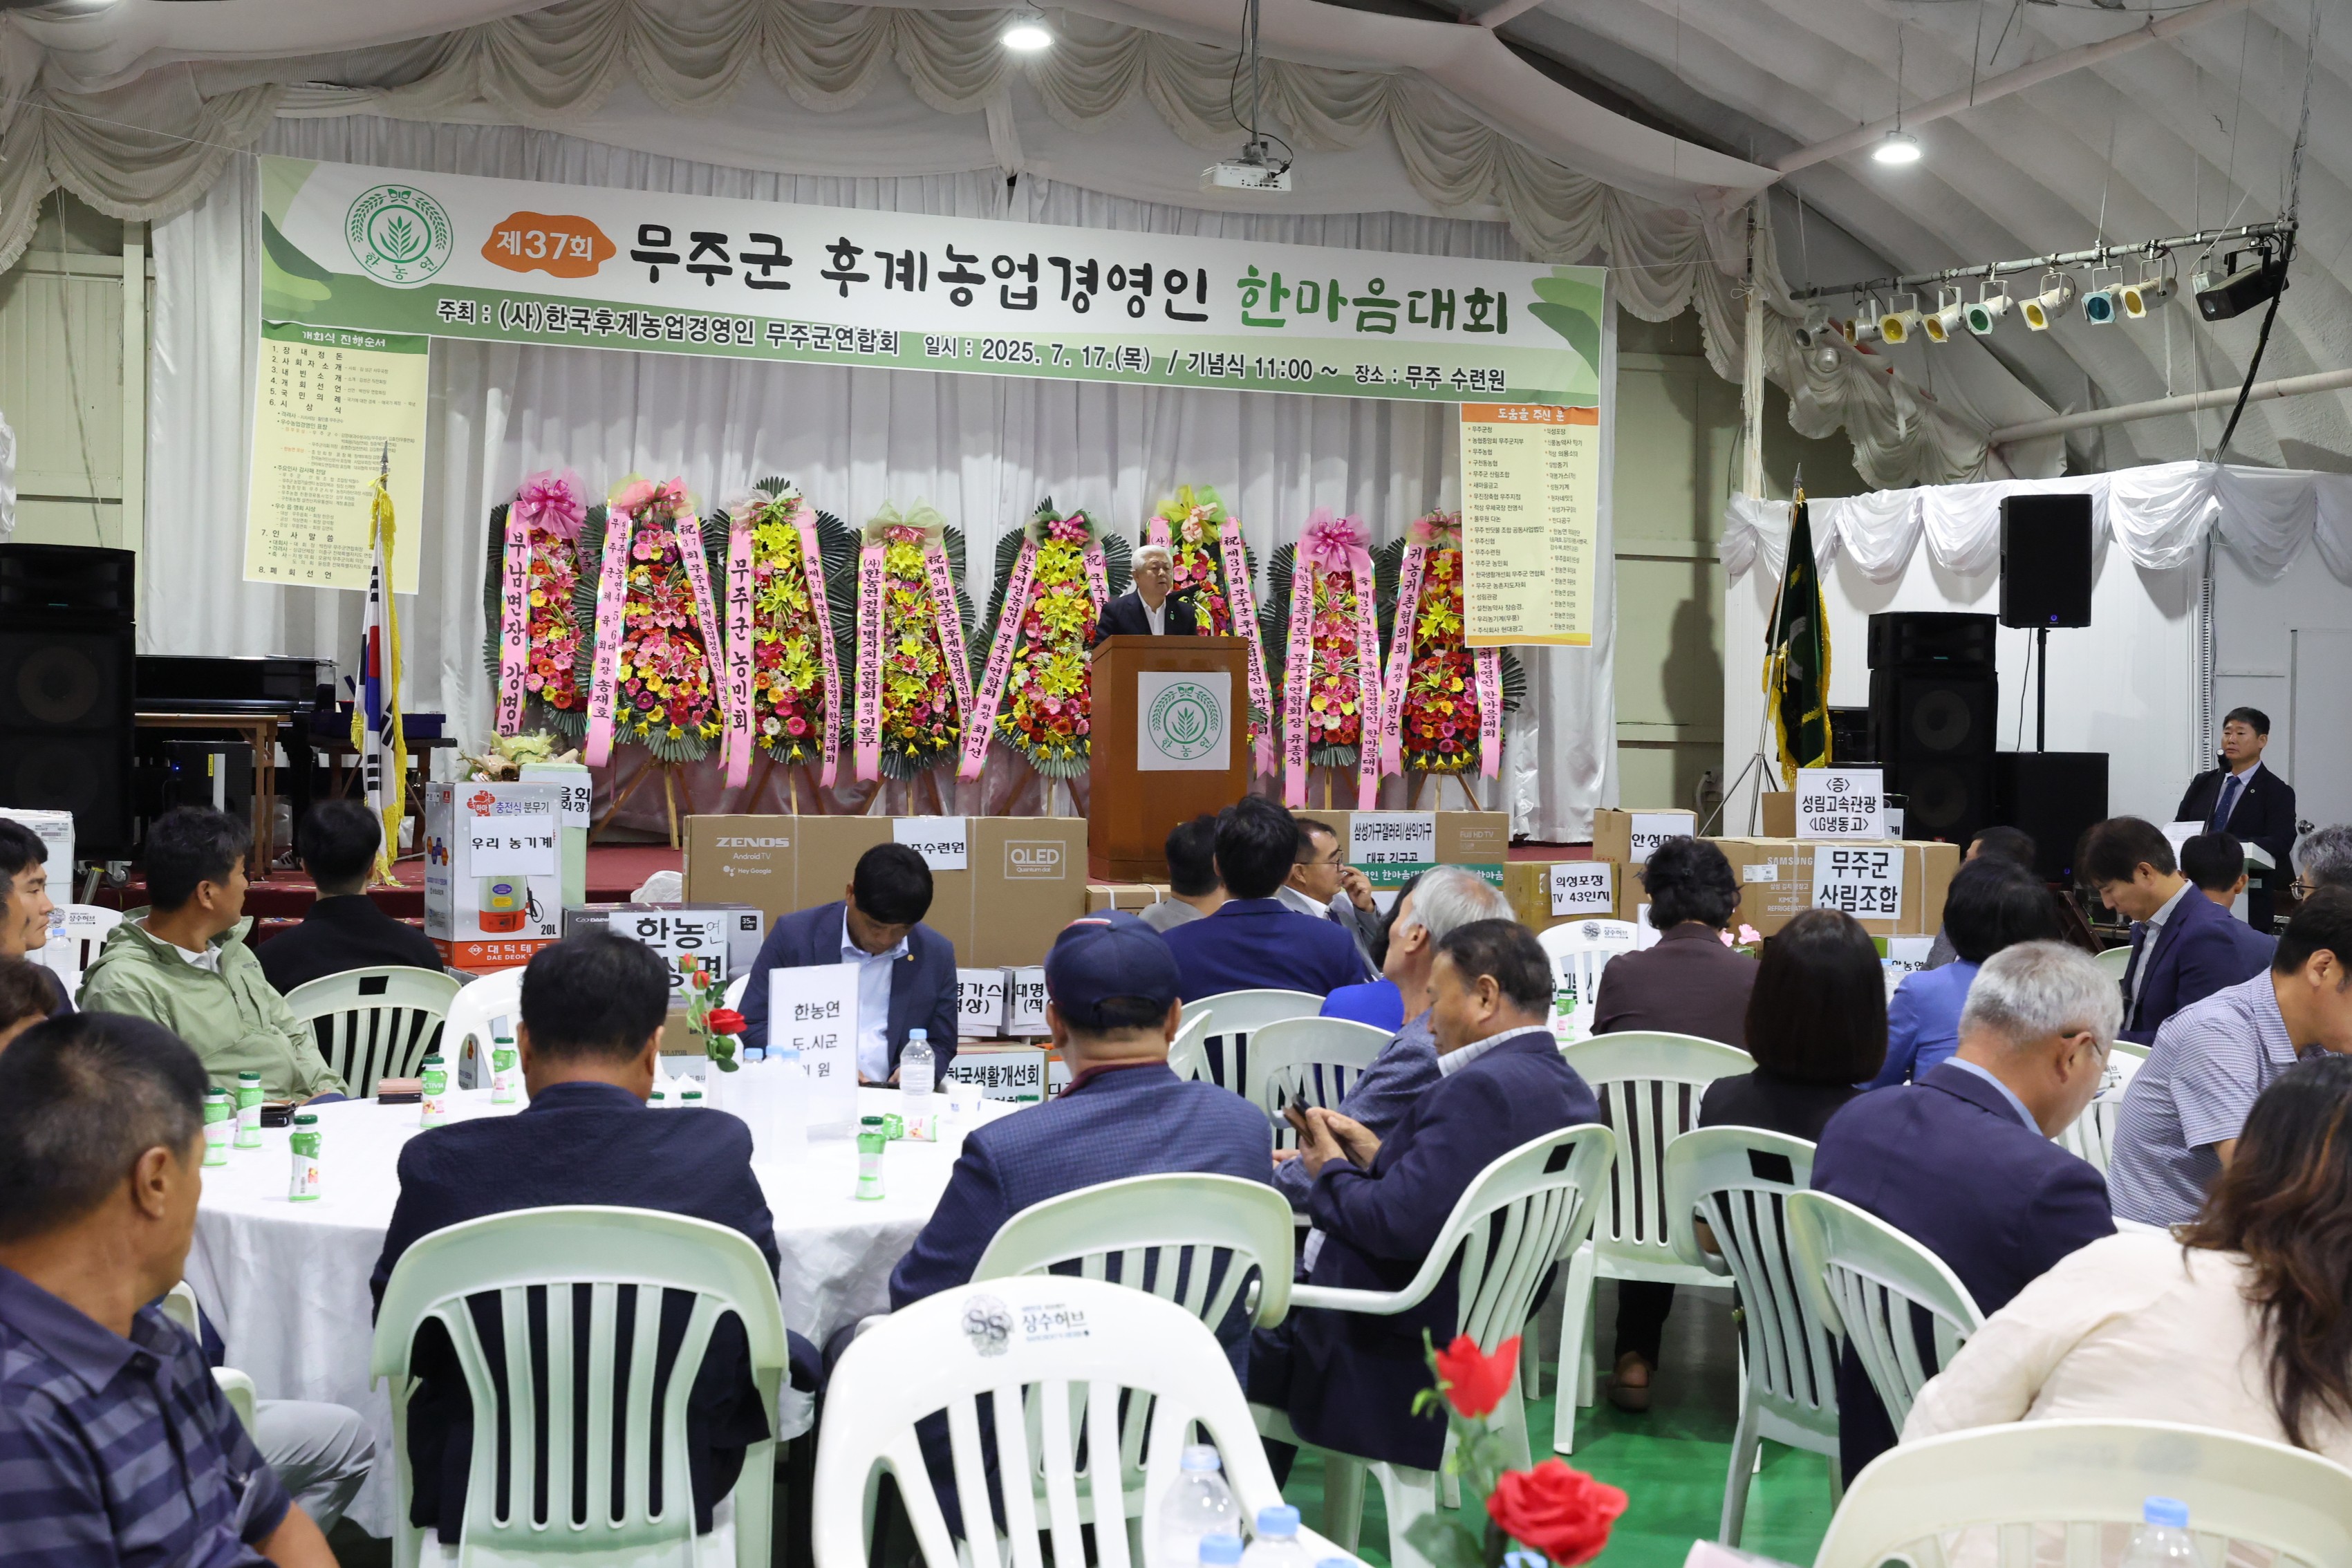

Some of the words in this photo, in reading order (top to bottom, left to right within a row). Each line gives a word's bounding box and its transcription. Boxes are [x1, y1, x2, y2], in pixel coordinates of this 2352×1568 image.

[496, 229, 594, 262] 제37회
[630, 223, 793, 291] 무주군
[821, 236, 1209, 322] 후계농업경영인
[1237, 264, 1509, 335] 한마음대회
[301, 330, 336, 343] 개회식
[340, 334, 386, 348] 진행순서
[437, 299, 475, 324] 주최
[498, 301, 756, 346] (사)한국후계농업경영인
[765, 323, 899, 355] 무주군연합회
[924, 335, 958, 357] 일시
[982, 339, 1040, 365] 2025.
[1050, 344, 1072, 366] 7.
[1082, 347, 1151, 373] 17.(목)
[1186, 351, 1245, 380] 기념식
[1255, 356, 1313, 381] 11:00
[1354, 364, 1385, 386] 장소
[1404, 364, 1442, 391] 무주
[1450, 368, 1506, 393] 수련원
[1497, 407, 1529, 420] 도움을
[1533, 409, 1551, 422] 주신
[1556, 409, 1565, 422] 분
[504, 532, 527, 647] 부남면장
[730, 557, 751, 642] 무주군
[1394, 546, 1424, 657] 귀농귀촌협의회
[982, 632, 1014, 700] 무주군연합회
[730, 651, 751, 736] 농민회
[1482, 690, 1499, 738] 한마음대회
[824, 711, 841, 765] 한마음대회
[967, 724, 987, 760] 최미선
[496, 801, 522, 813] 충전식
[523, 801, 550, 813] 분무기
[1802, 795, 1876, 814] 성림고속관광
[715, 837, 790, 848] ZENOS
[1354, 822, 1432, 841] 삼성가구갤러리/삼익가구
[472, 837, 499, 850] 우리
[509, 837, 553, 850] 농기계
[732, 852, 760, 861] Android
[1010, 848, 1060, 866] QLED
[1832, 851, 1888, 879] 무주군
[738, 867, 749, 875] Hey
[750, 867, 772, 875] Google
[1556, 874, 1604, 888] 의성포장
[1552, 893, 1564, 904] TV
[1569, 890, 1610, 904] 43인치
[1819, 884, 1897, 912] 산림조합
[541, 924, 557, 935] 20L
[794, 999, 841, 1022] 한농연
[1023, 1311, 1088, 1334] 상수허브
